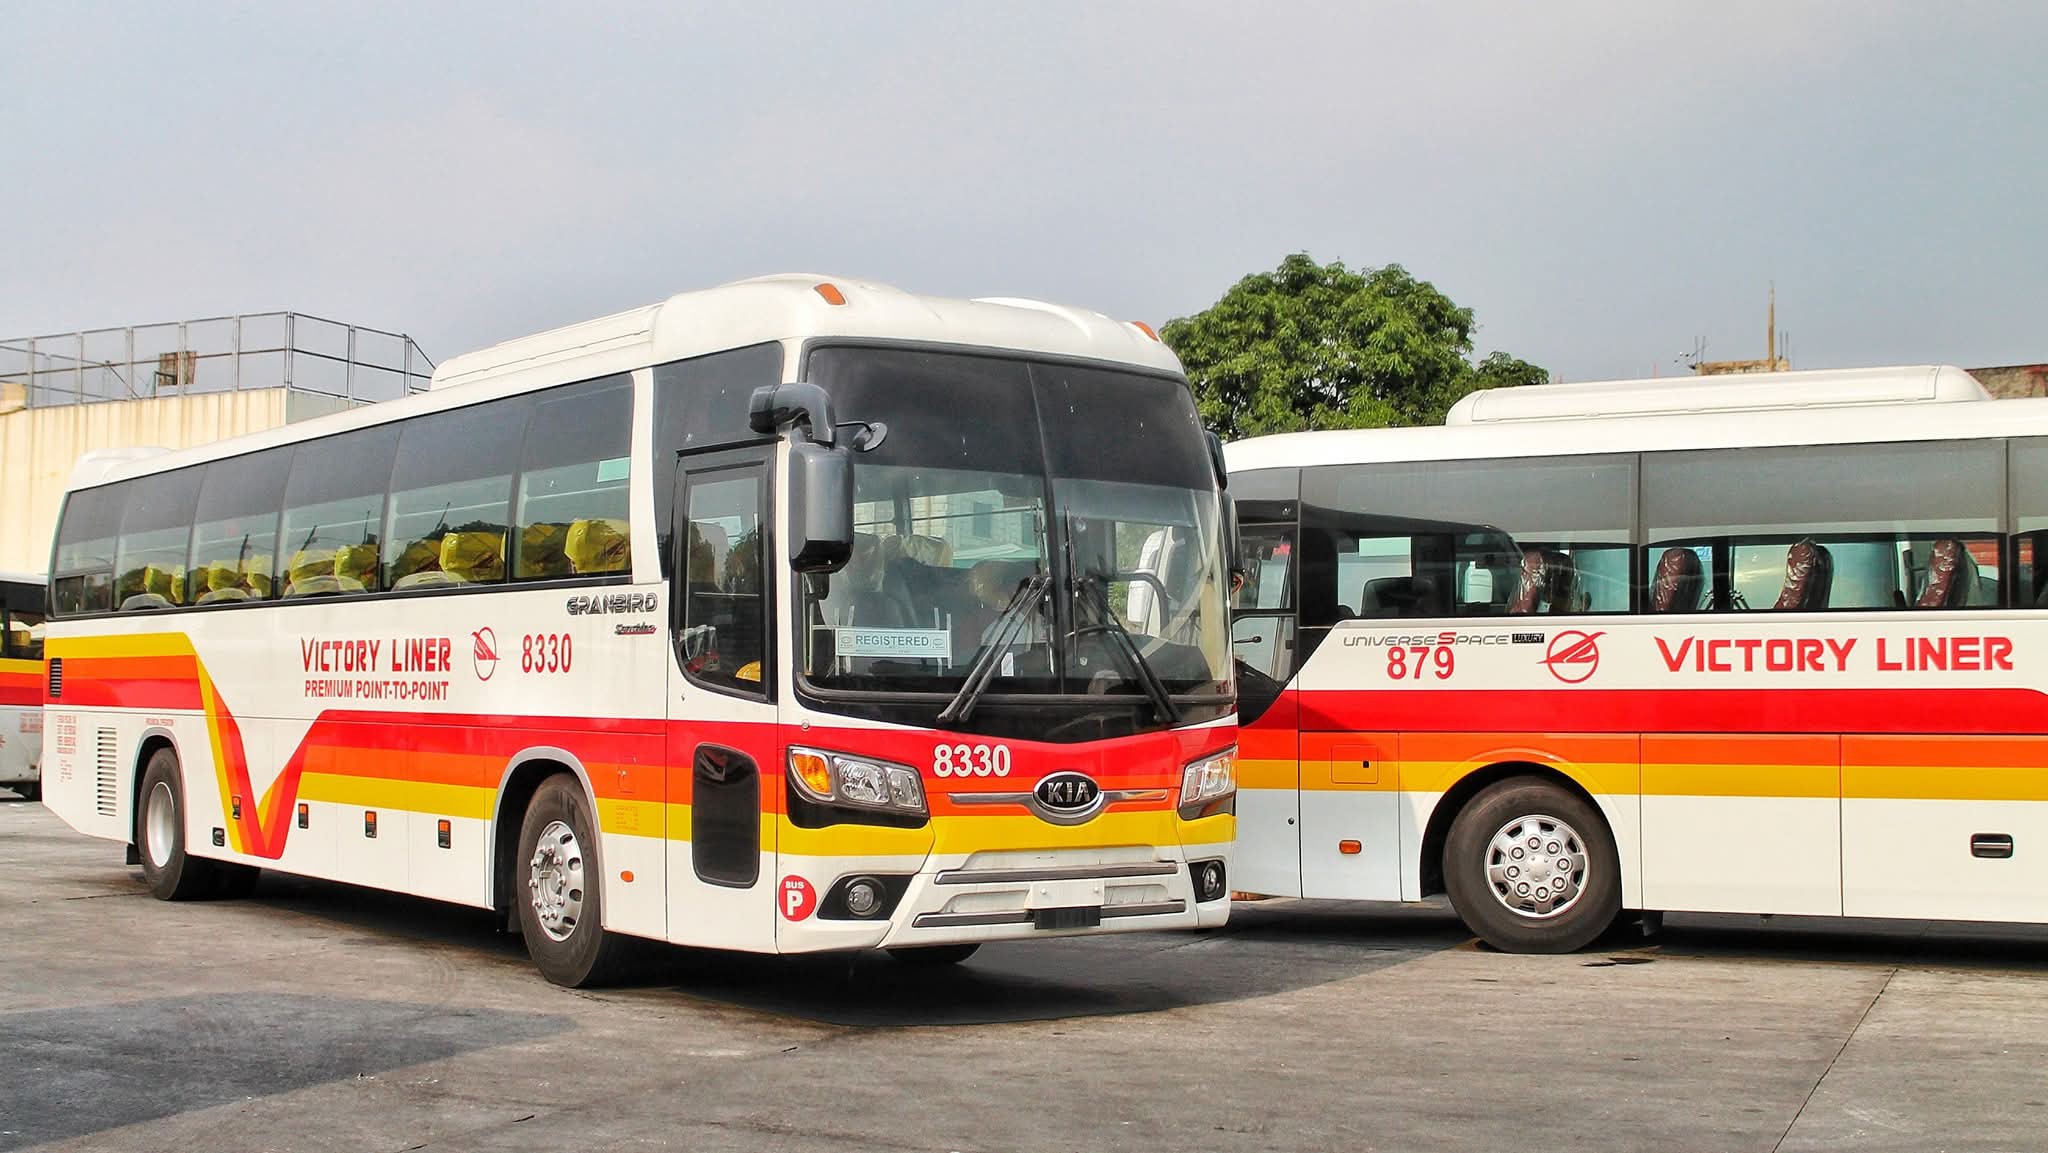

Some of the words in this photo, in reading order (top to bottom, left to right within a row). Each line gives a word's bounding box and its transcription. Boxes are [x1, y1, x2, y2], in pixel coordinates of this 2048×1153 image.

[567, 593, 658, 615] GRANBIRD
[522, 633, 572, 673] 8330
[855, 635, 929, 646] REGISTERED
[300, 637, 380, 672] VICTORY
[391, 638, 451, 672] LINER
[1387, 646, 1455, 680] 879
[1654, 636, 1857, 672] VICTORY
[1876, 636, 2013, 672] LINER
[305, 680, 352, 698] PREMIUM
[356, 681, 449, 700] POINT-TO-POINT
[933, 744, 1011, 777] 8330
[1047, 781, 1090, 803] KIA
[785, 881, 805, 889] BUS
[786, 890, 804, 916] P
